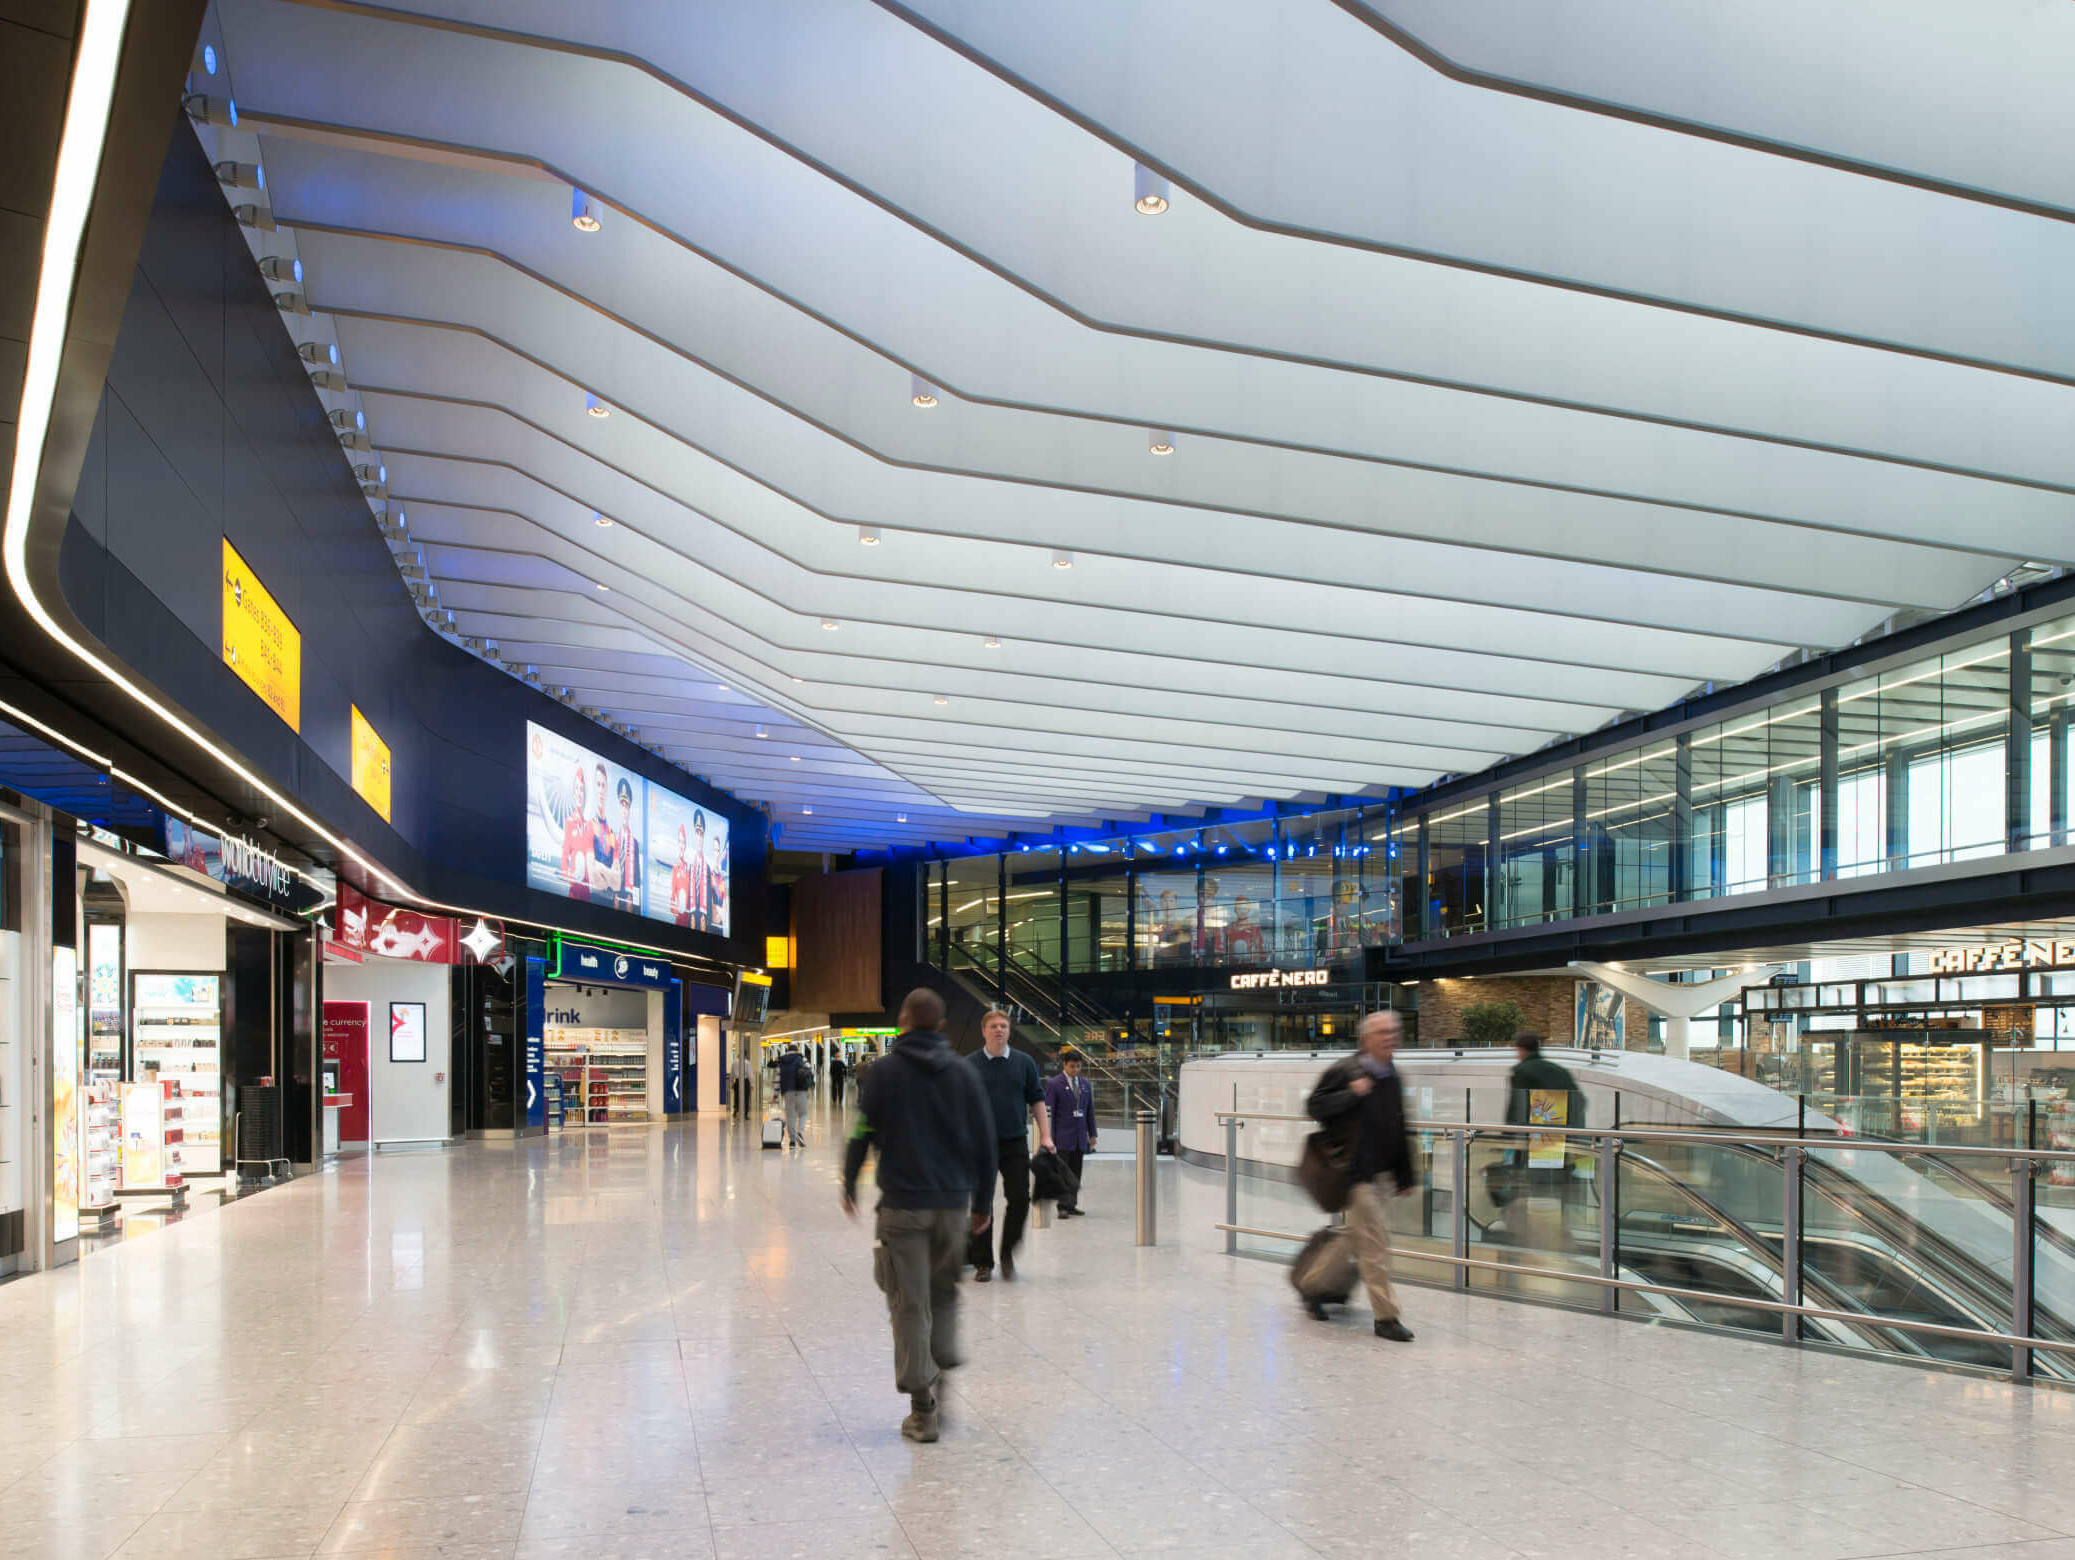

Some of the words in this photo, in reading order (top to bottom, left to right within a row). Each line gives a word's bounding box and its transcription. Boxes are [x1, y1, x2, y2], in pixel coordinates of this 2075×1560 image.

[1929, 935, 2026, 972] CAFFÈ
[1230, 968, 1280, 989] CAFFÈ
[1281, 969, 1329, 986] NERO
[330, 1019, 367, 1028] currency
[543, 1007, 581, 1024] rink
